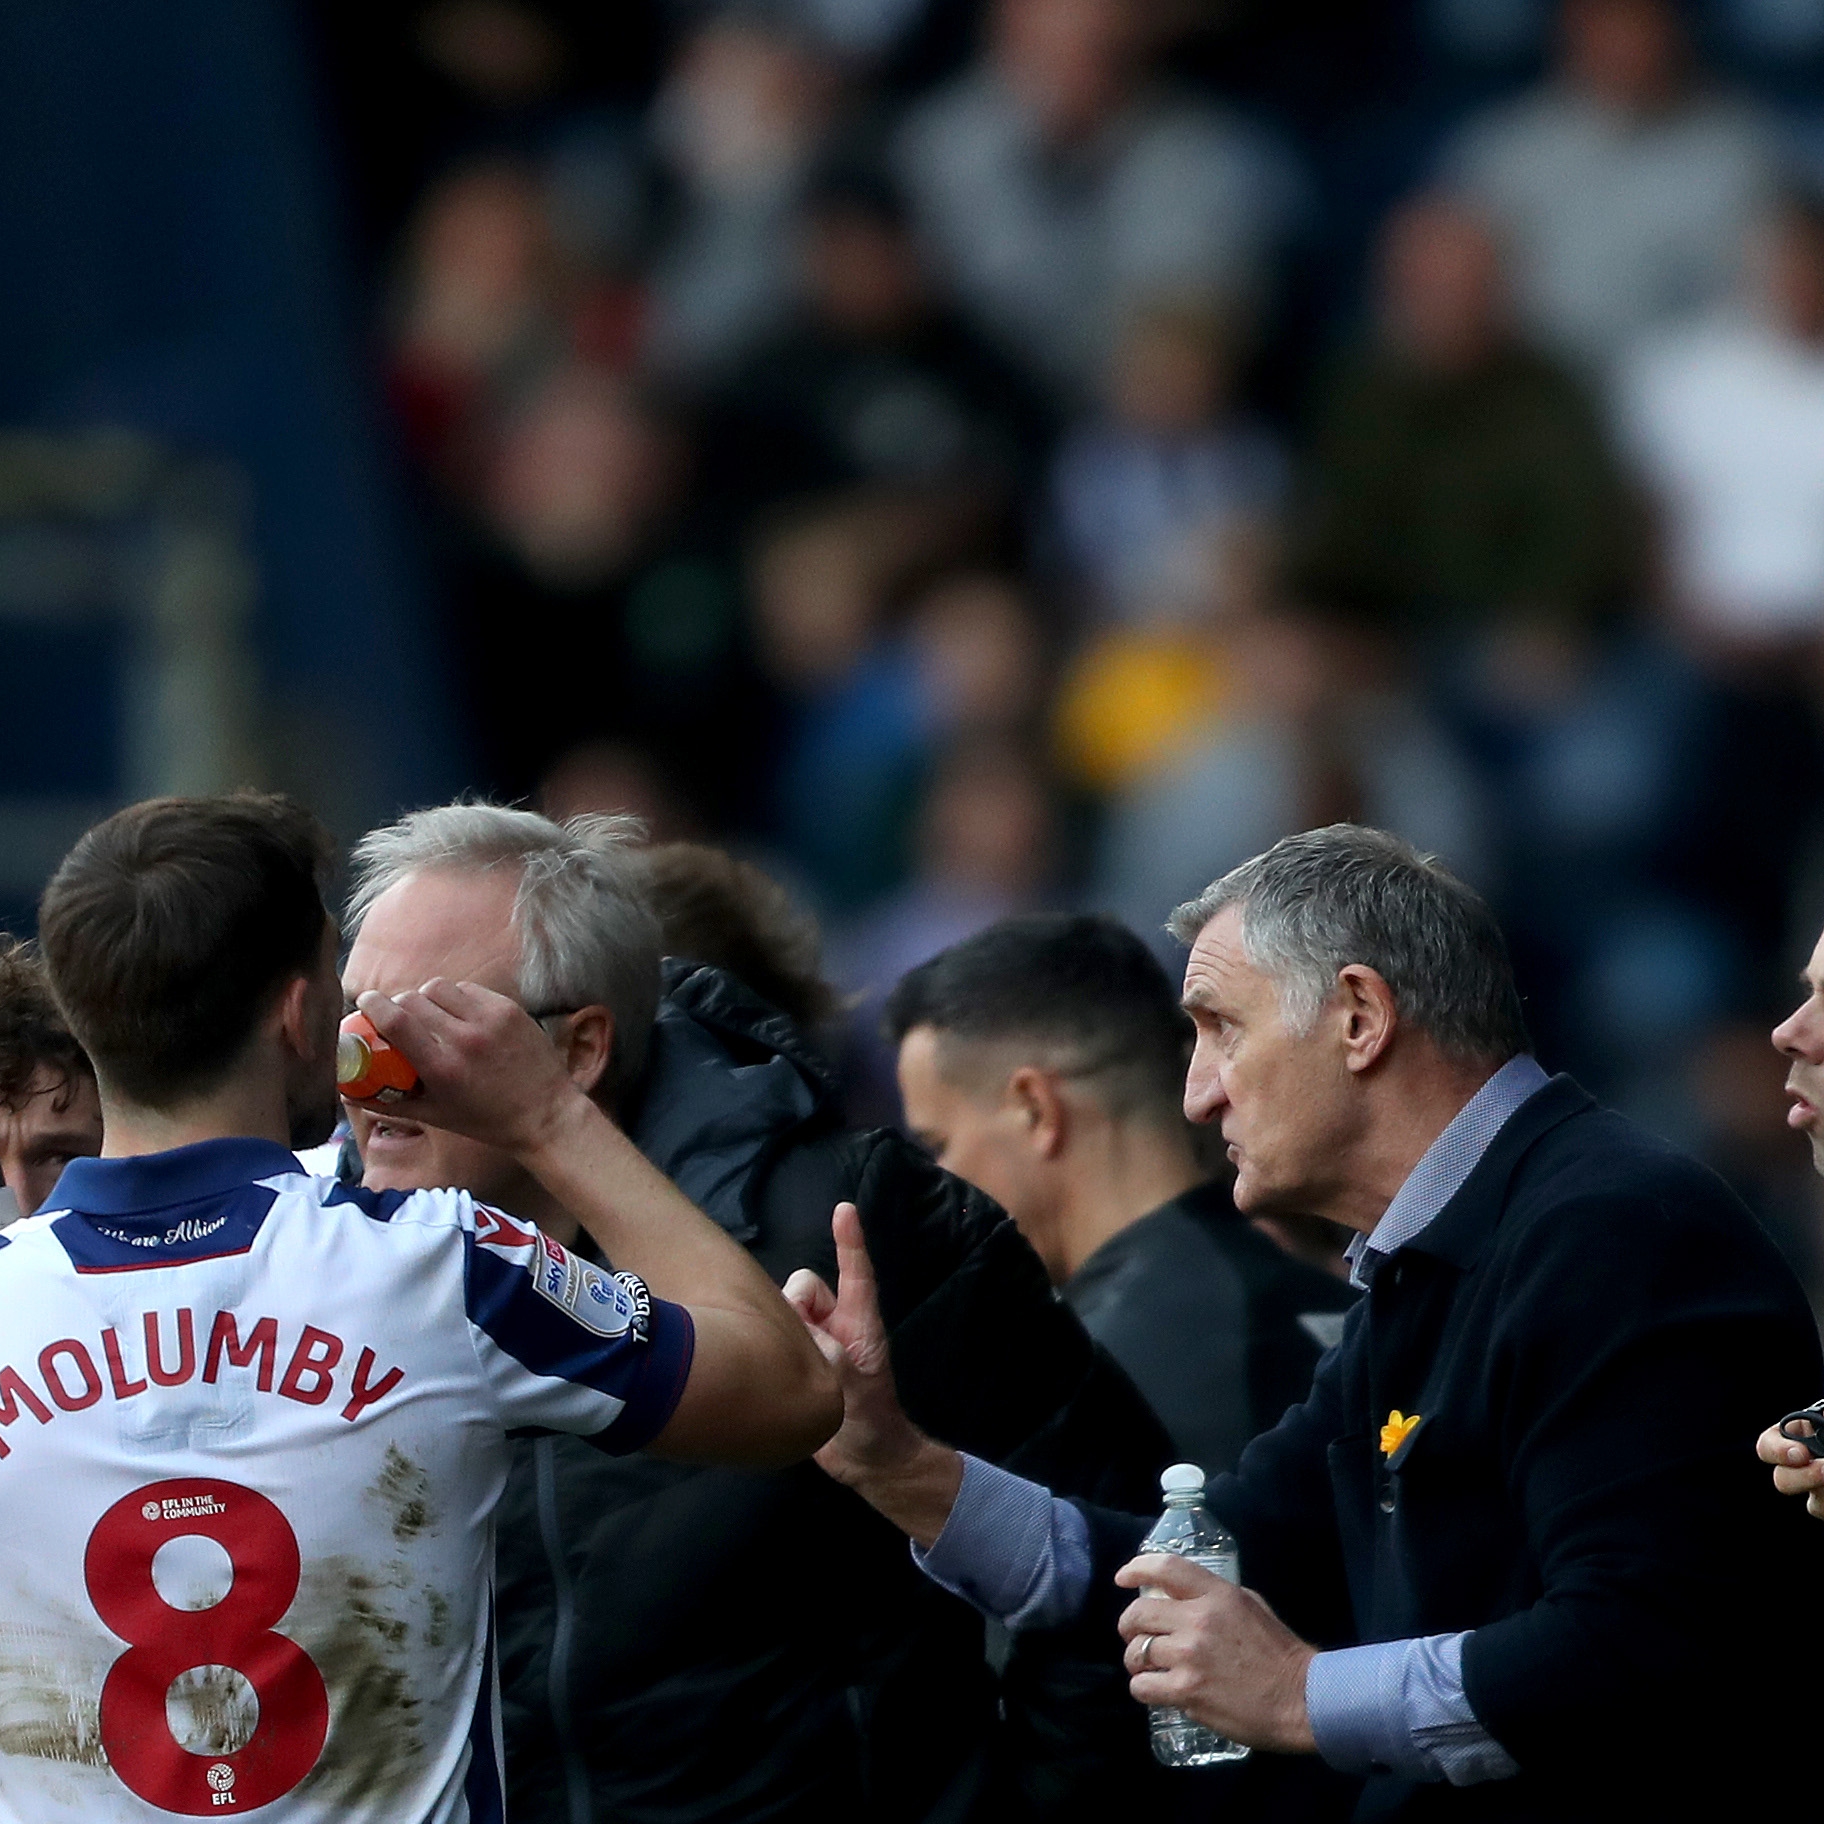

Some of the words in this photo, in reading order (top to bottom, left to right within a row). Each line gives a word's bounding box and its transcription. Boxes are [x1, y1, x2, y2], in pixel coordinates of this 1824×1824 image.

[131, 1234, 161, 1247] are
[164, 1215, 229, 1245] Albion
[615, 1292, 628, 1317] EFL
[161, 1499, 181, 1509] EFL
[181, 1497, 194, 1507] IN
[194, 1494, 214, 1506] THE
[163, 1502, 227, 1519] COMMUNITY
[84, 1476, 330, 1817] 8
[211, 1791, 236, 1806] EFL
